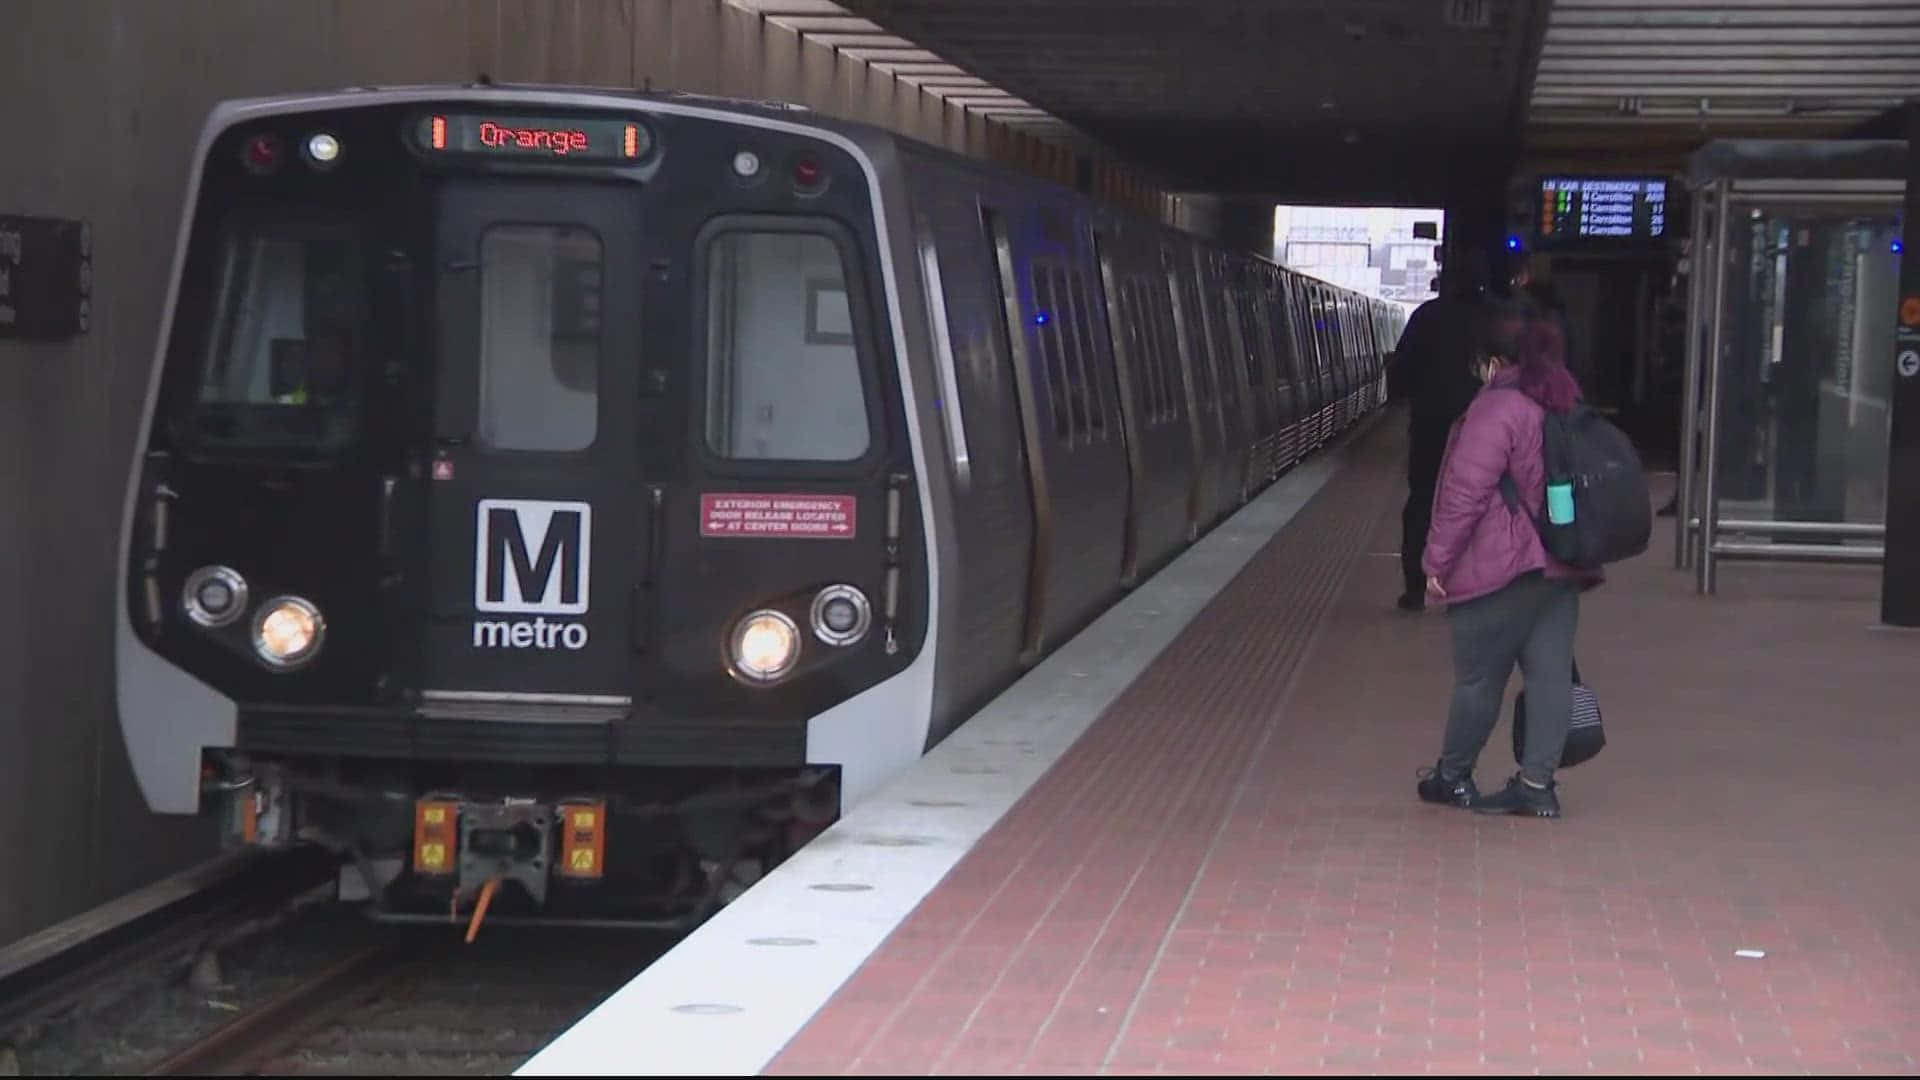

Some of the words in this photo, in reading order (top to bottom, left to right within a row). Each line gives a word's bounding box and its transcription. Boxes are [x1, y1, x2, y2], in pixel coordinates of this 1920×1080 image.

[480, 121, 588, 155] Orange
[1559, 181, 1579, 191] CAR
[1582, 181, 1640, 191] DESTINATION
[1582, 191, 1590, 202] N
[1581, 203, 1589, 213] N
[1580, 214, 1589, 224] N
[1580, 225, 1588, 235] N
[715, 500, 771, 509] EXTERIOR
[773, 501, 840, 510] EMERGENCY
[709, 511, 742, 520] DOOR
[743, 511, 793, 520] RELEASE
[796, 512, 846, 521] LOCATED
[727, 522, 741, 531] AT
[743, 522, 788, 531] CENTER
[790, 523, 828, 532] DOORS
[486, 508, 581, 604] M
[473, 617, 587, 649] metro
